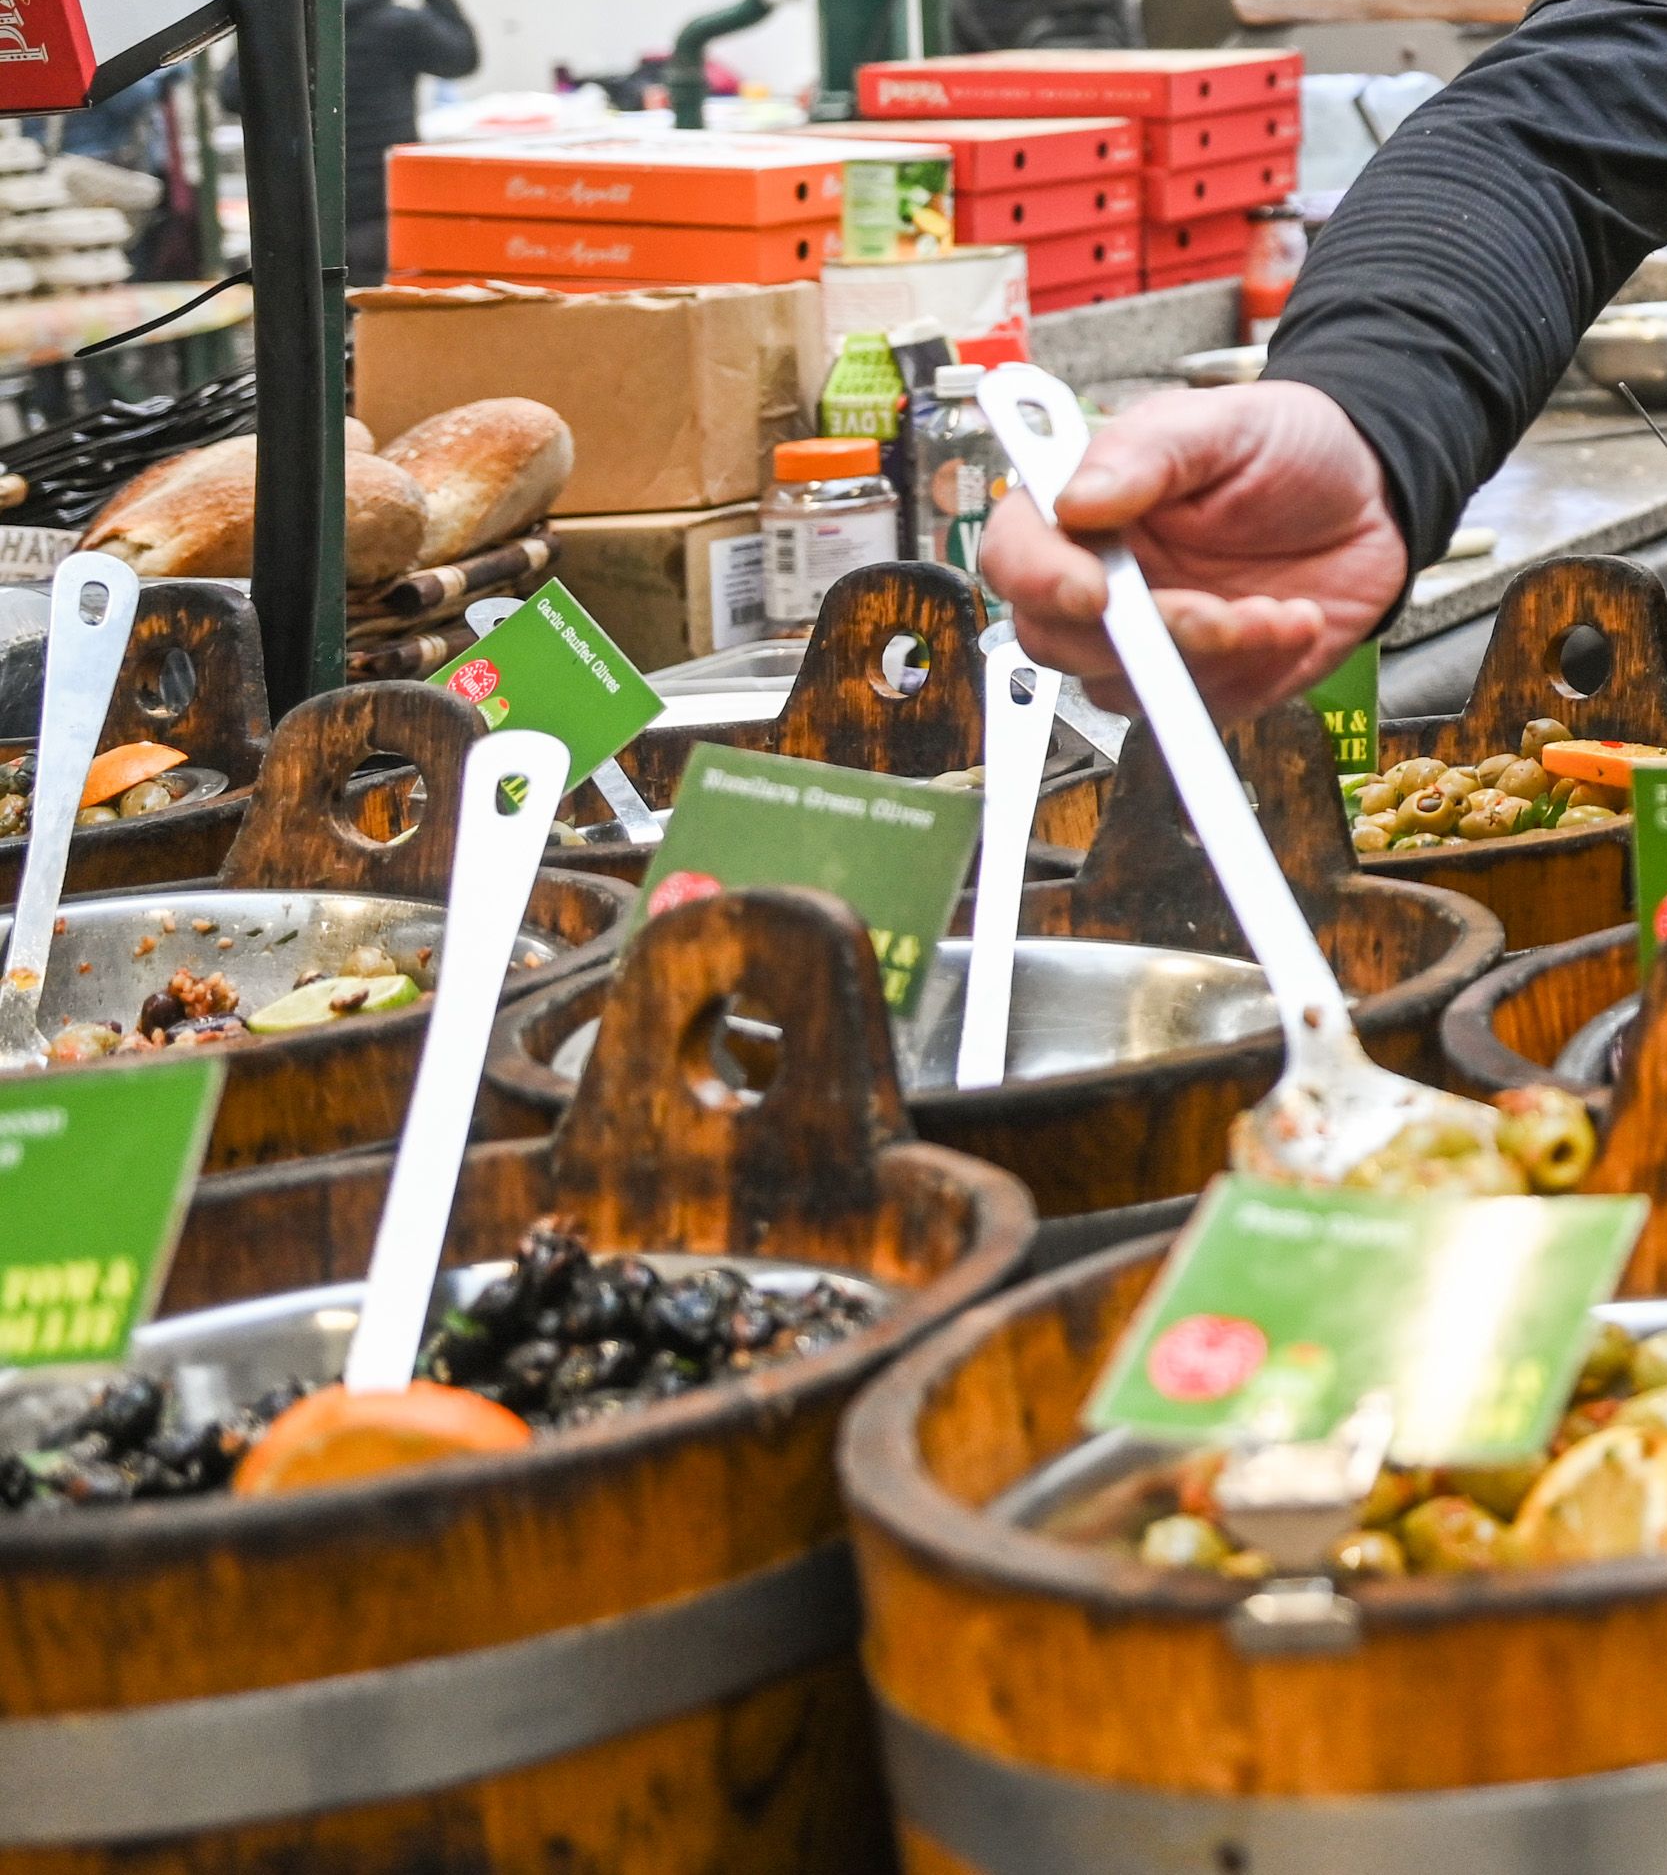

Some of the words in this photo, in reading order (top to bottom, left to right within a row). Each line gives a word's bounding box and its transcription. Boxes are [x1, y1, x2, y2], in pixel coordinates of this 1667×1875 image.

[536, 596, 565, 631] Garlic
[560, 625, 597, 667] Stuffed
[591, 658, 622, 695] Olives
[458, 670, 481, 696] Tom
[1350, 709, 1368, 733] &
